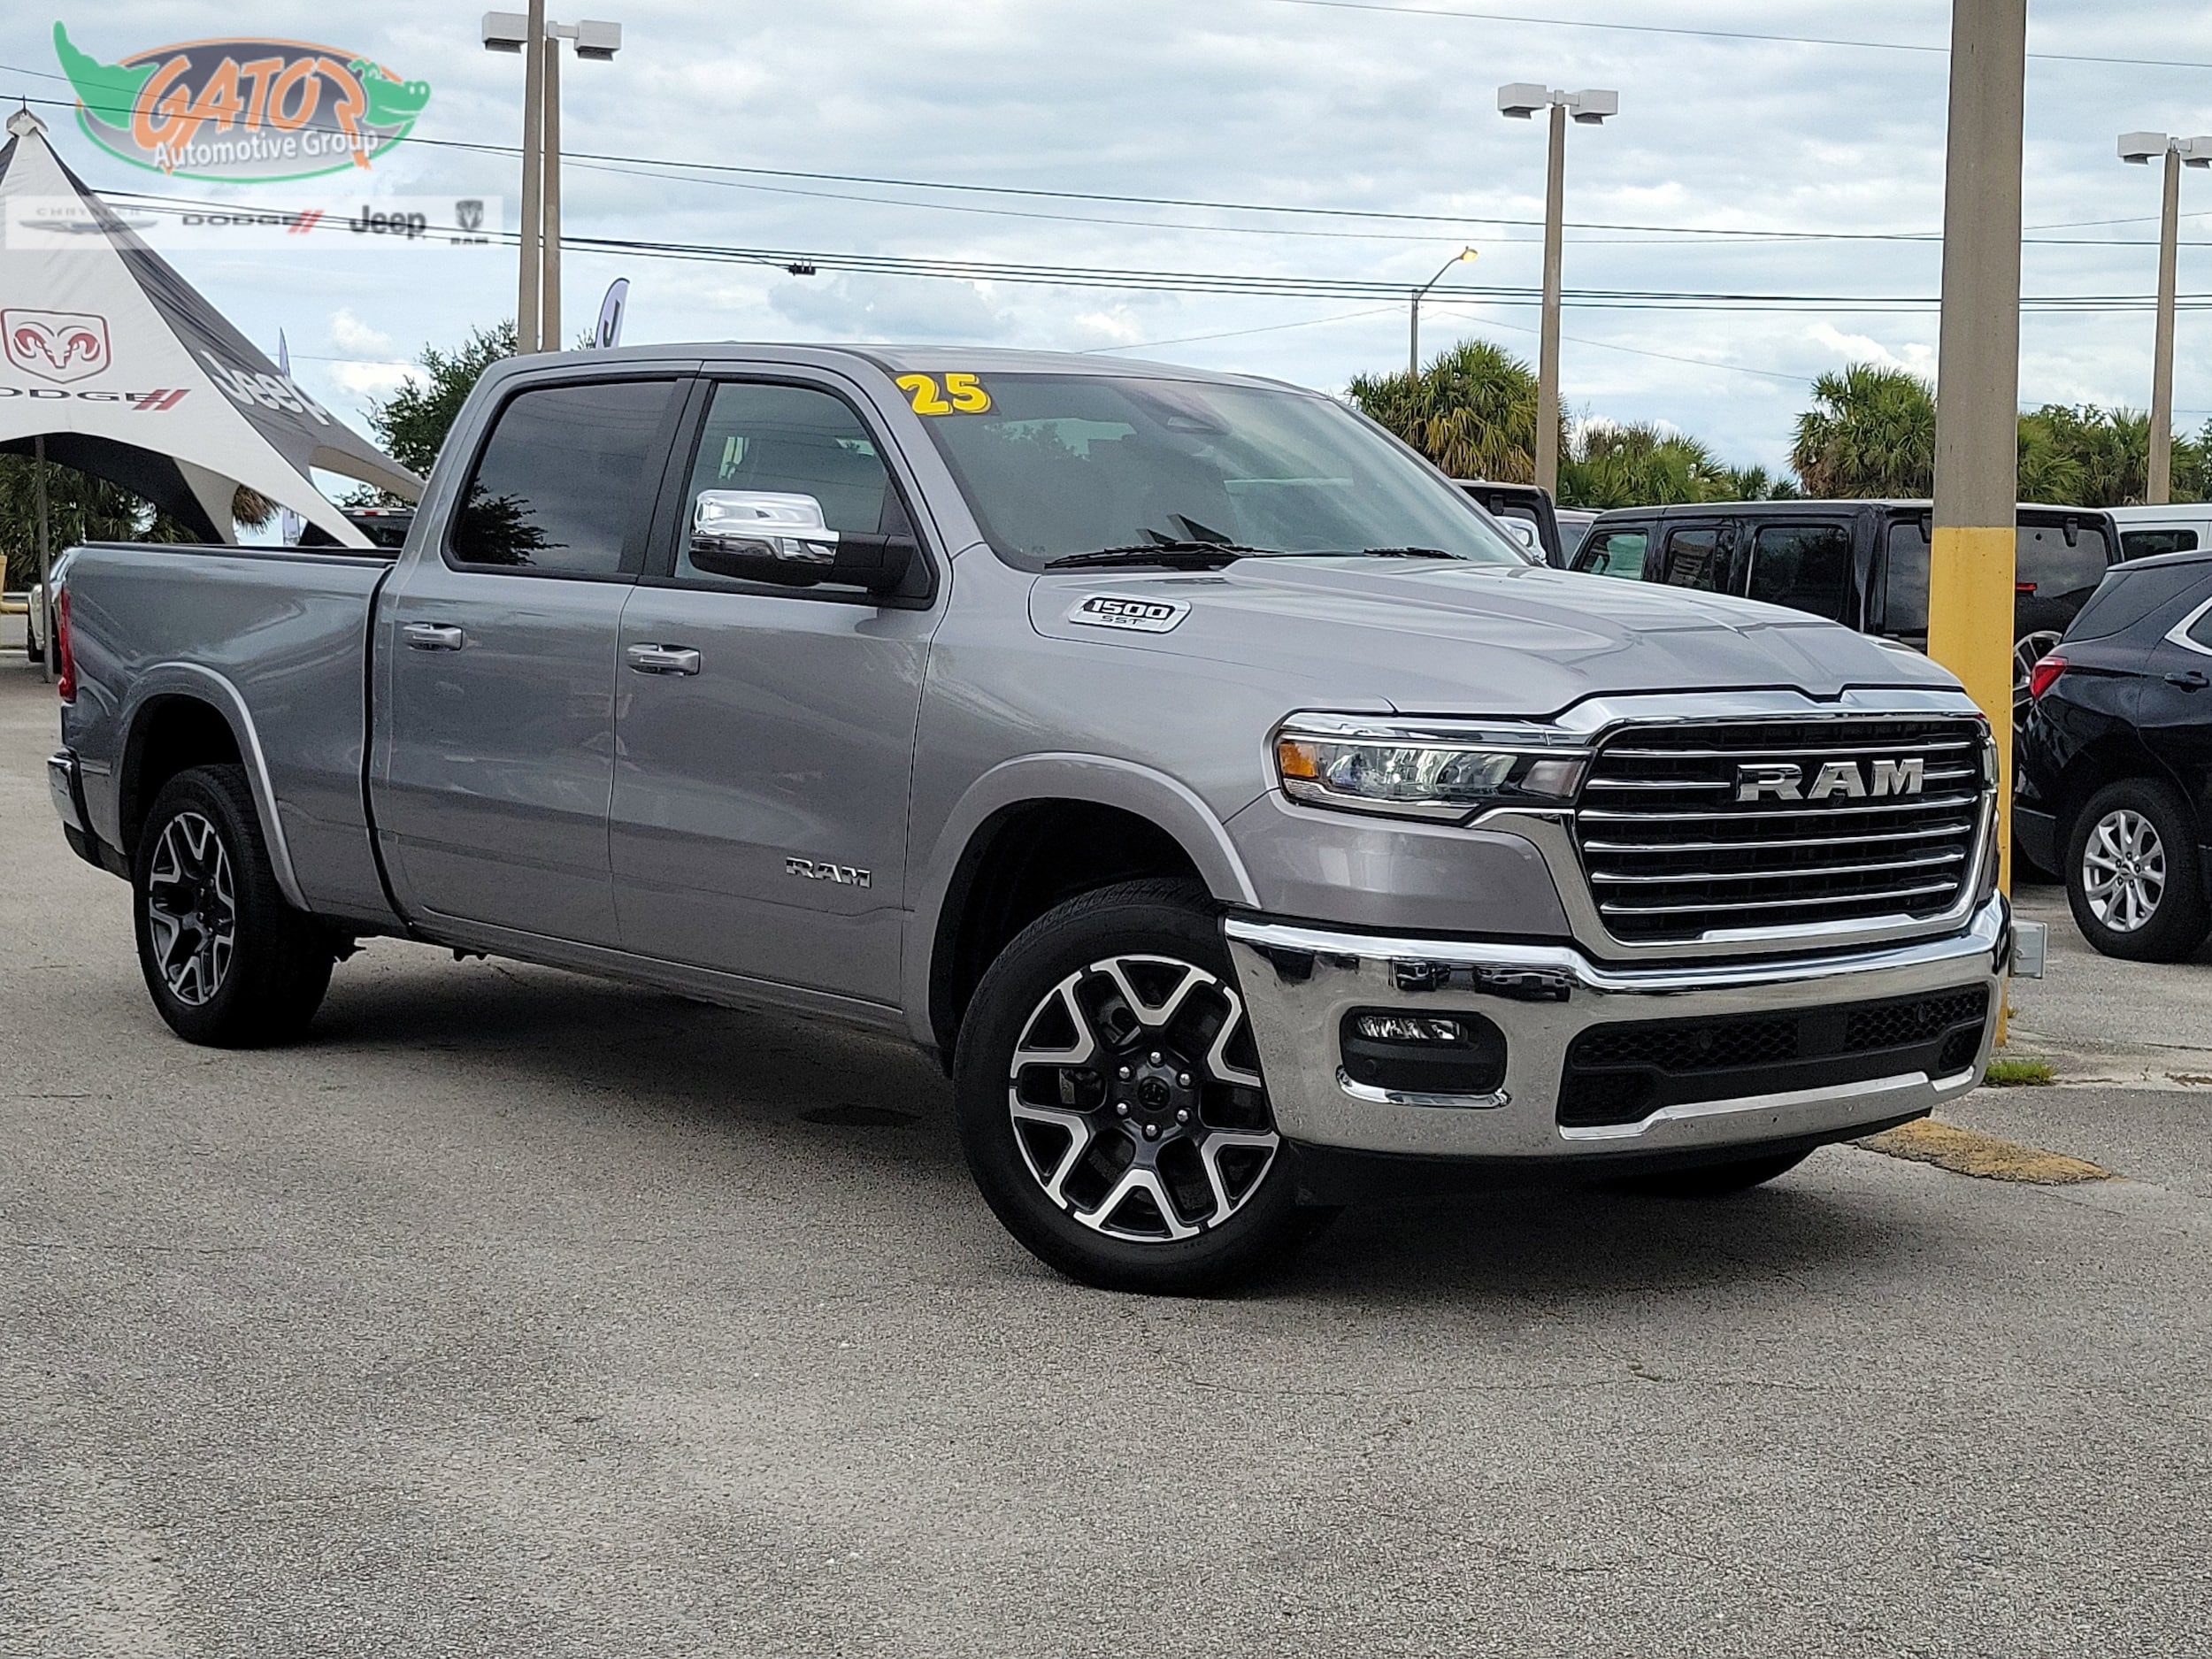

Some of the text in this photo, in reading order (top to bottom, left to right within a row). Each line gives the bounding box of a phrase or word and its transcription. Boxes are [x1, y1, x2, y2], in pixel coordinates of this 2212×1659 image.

[200, 349, 331, 426] Jeep
[895, 373, 992, 416] 25
[1091, 599, 1171, 618] 1500
[1736, 757, 1924, 802] RAM
[785, 856, 872, 888] RAM
